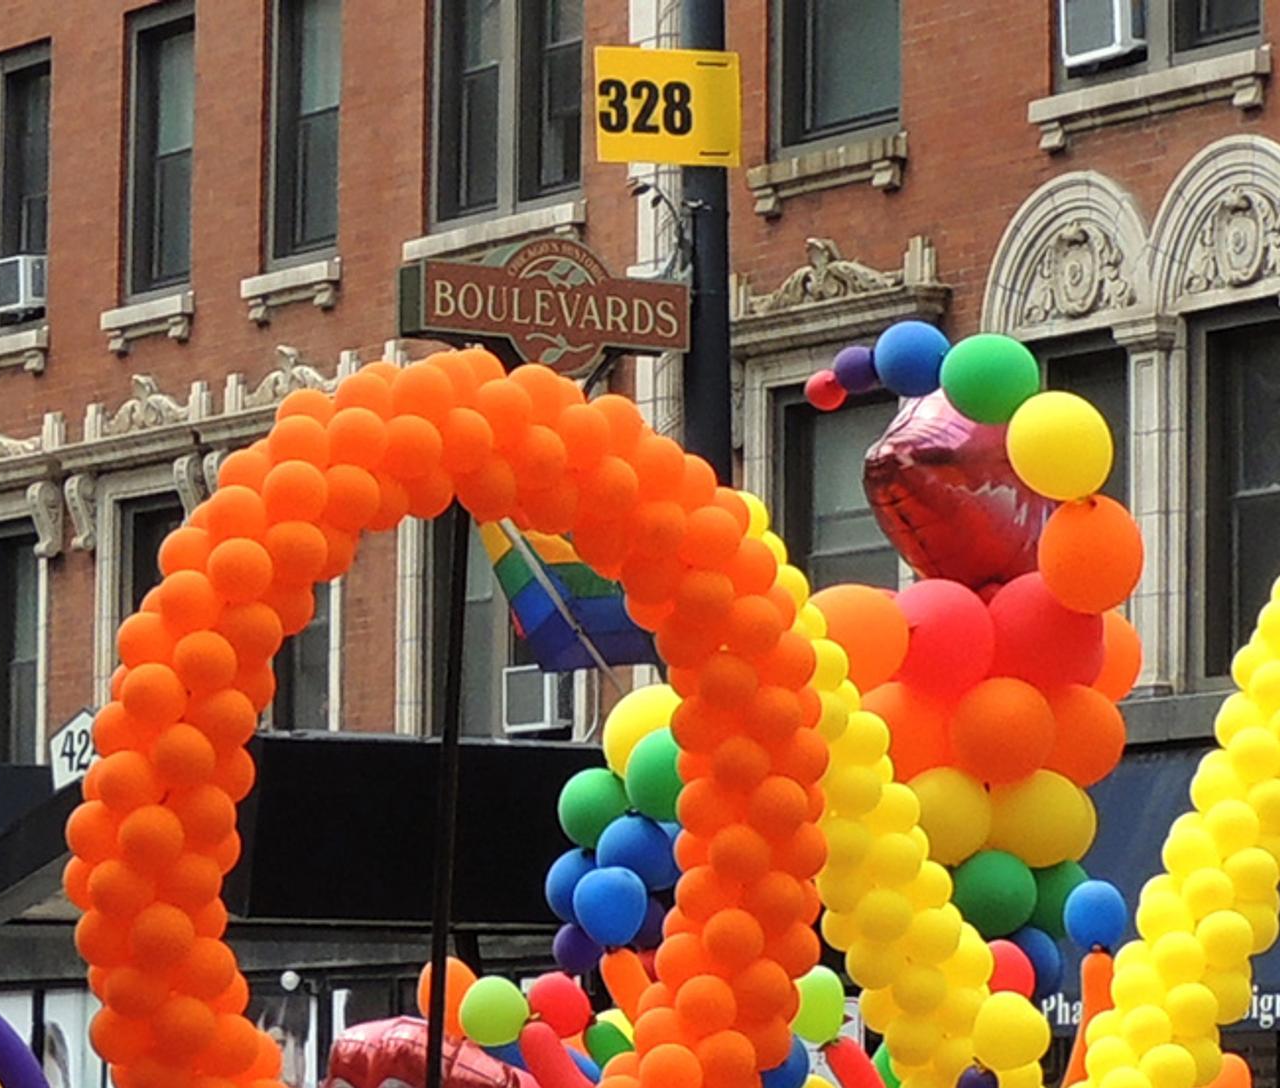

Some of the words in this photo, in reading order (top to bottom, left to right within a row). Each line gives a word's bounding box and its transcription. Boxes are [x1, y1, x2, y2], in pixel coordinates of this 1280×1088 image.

[598, 79, 693, 136] 328
[433, 279, 679, 338] BOULEVARDS
[60, 729, 98, 772] 42
